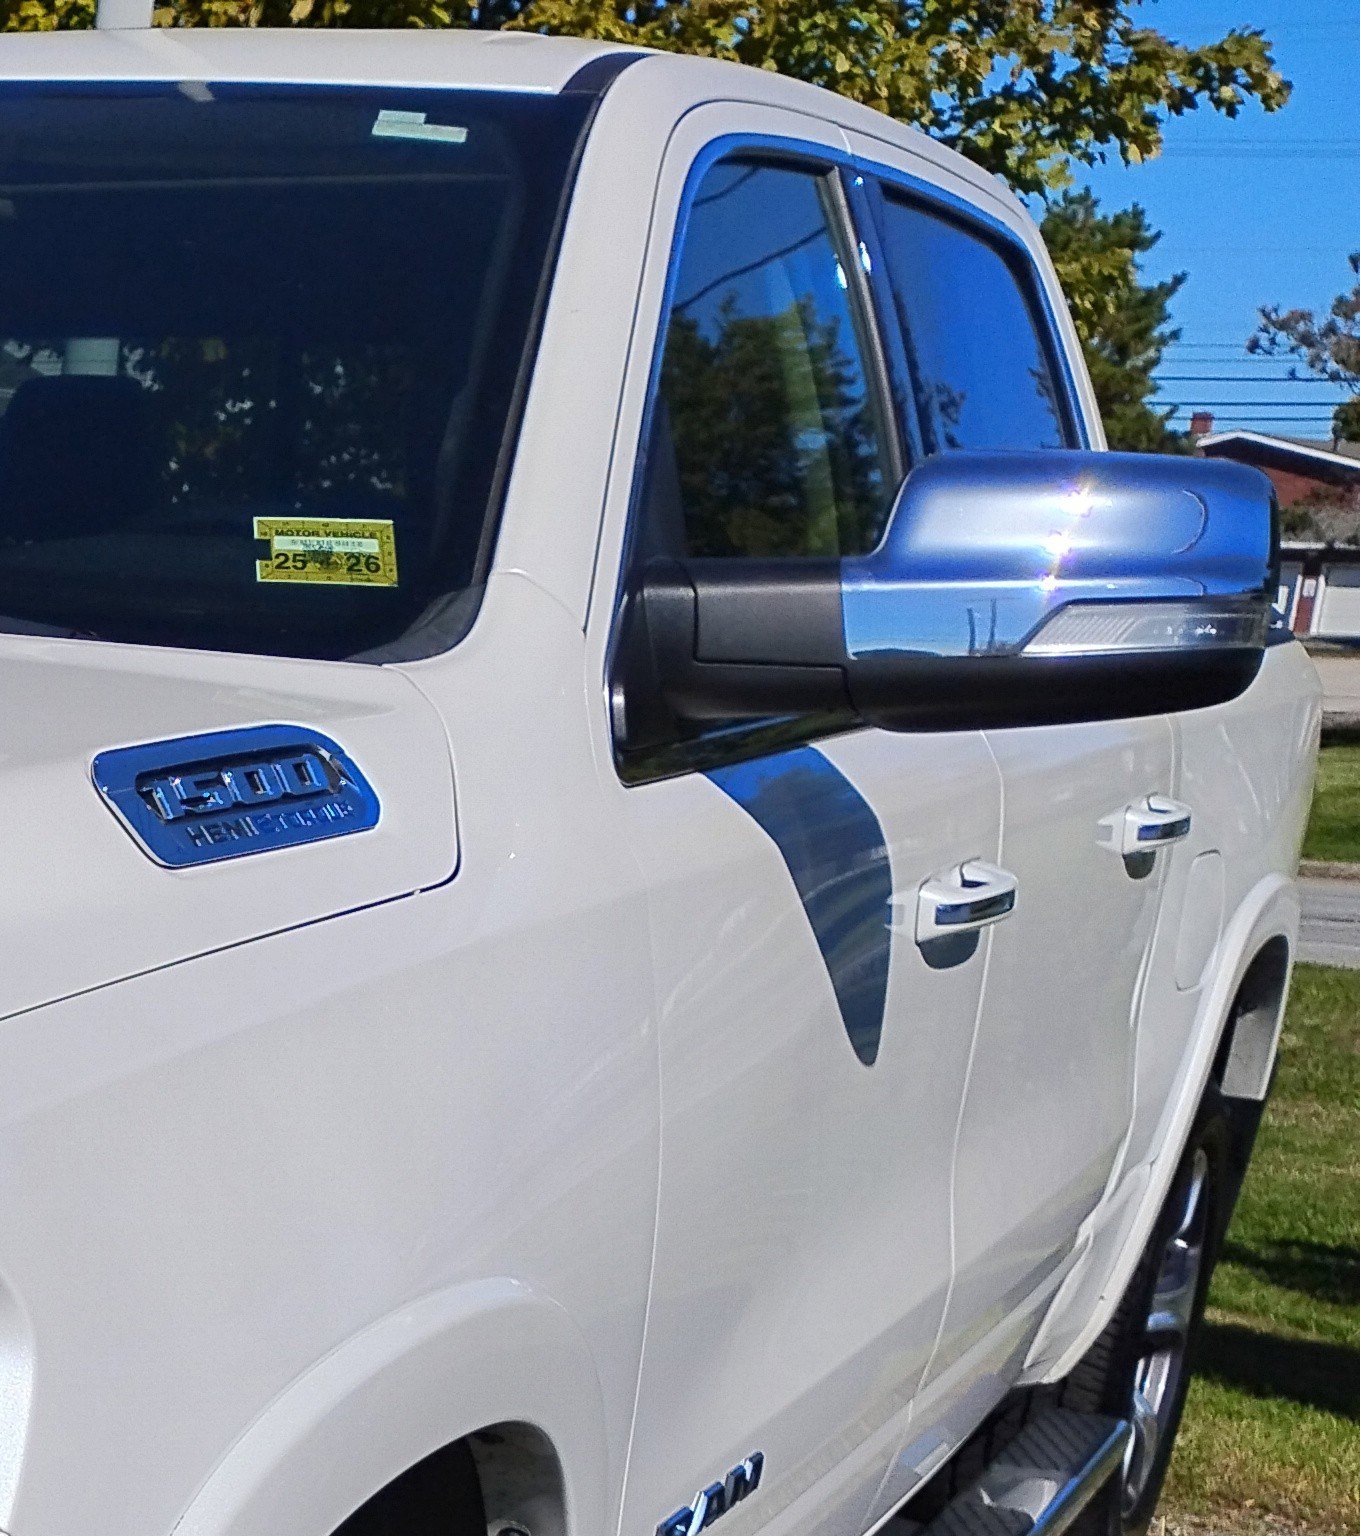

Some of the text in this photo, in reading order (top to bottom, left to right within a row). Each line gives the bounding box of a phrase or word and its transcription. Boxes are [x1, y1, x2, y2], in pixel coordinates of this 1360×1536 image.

[274, 553, 381, 574] 25 26
[139, 752, 330, 822] 1500
